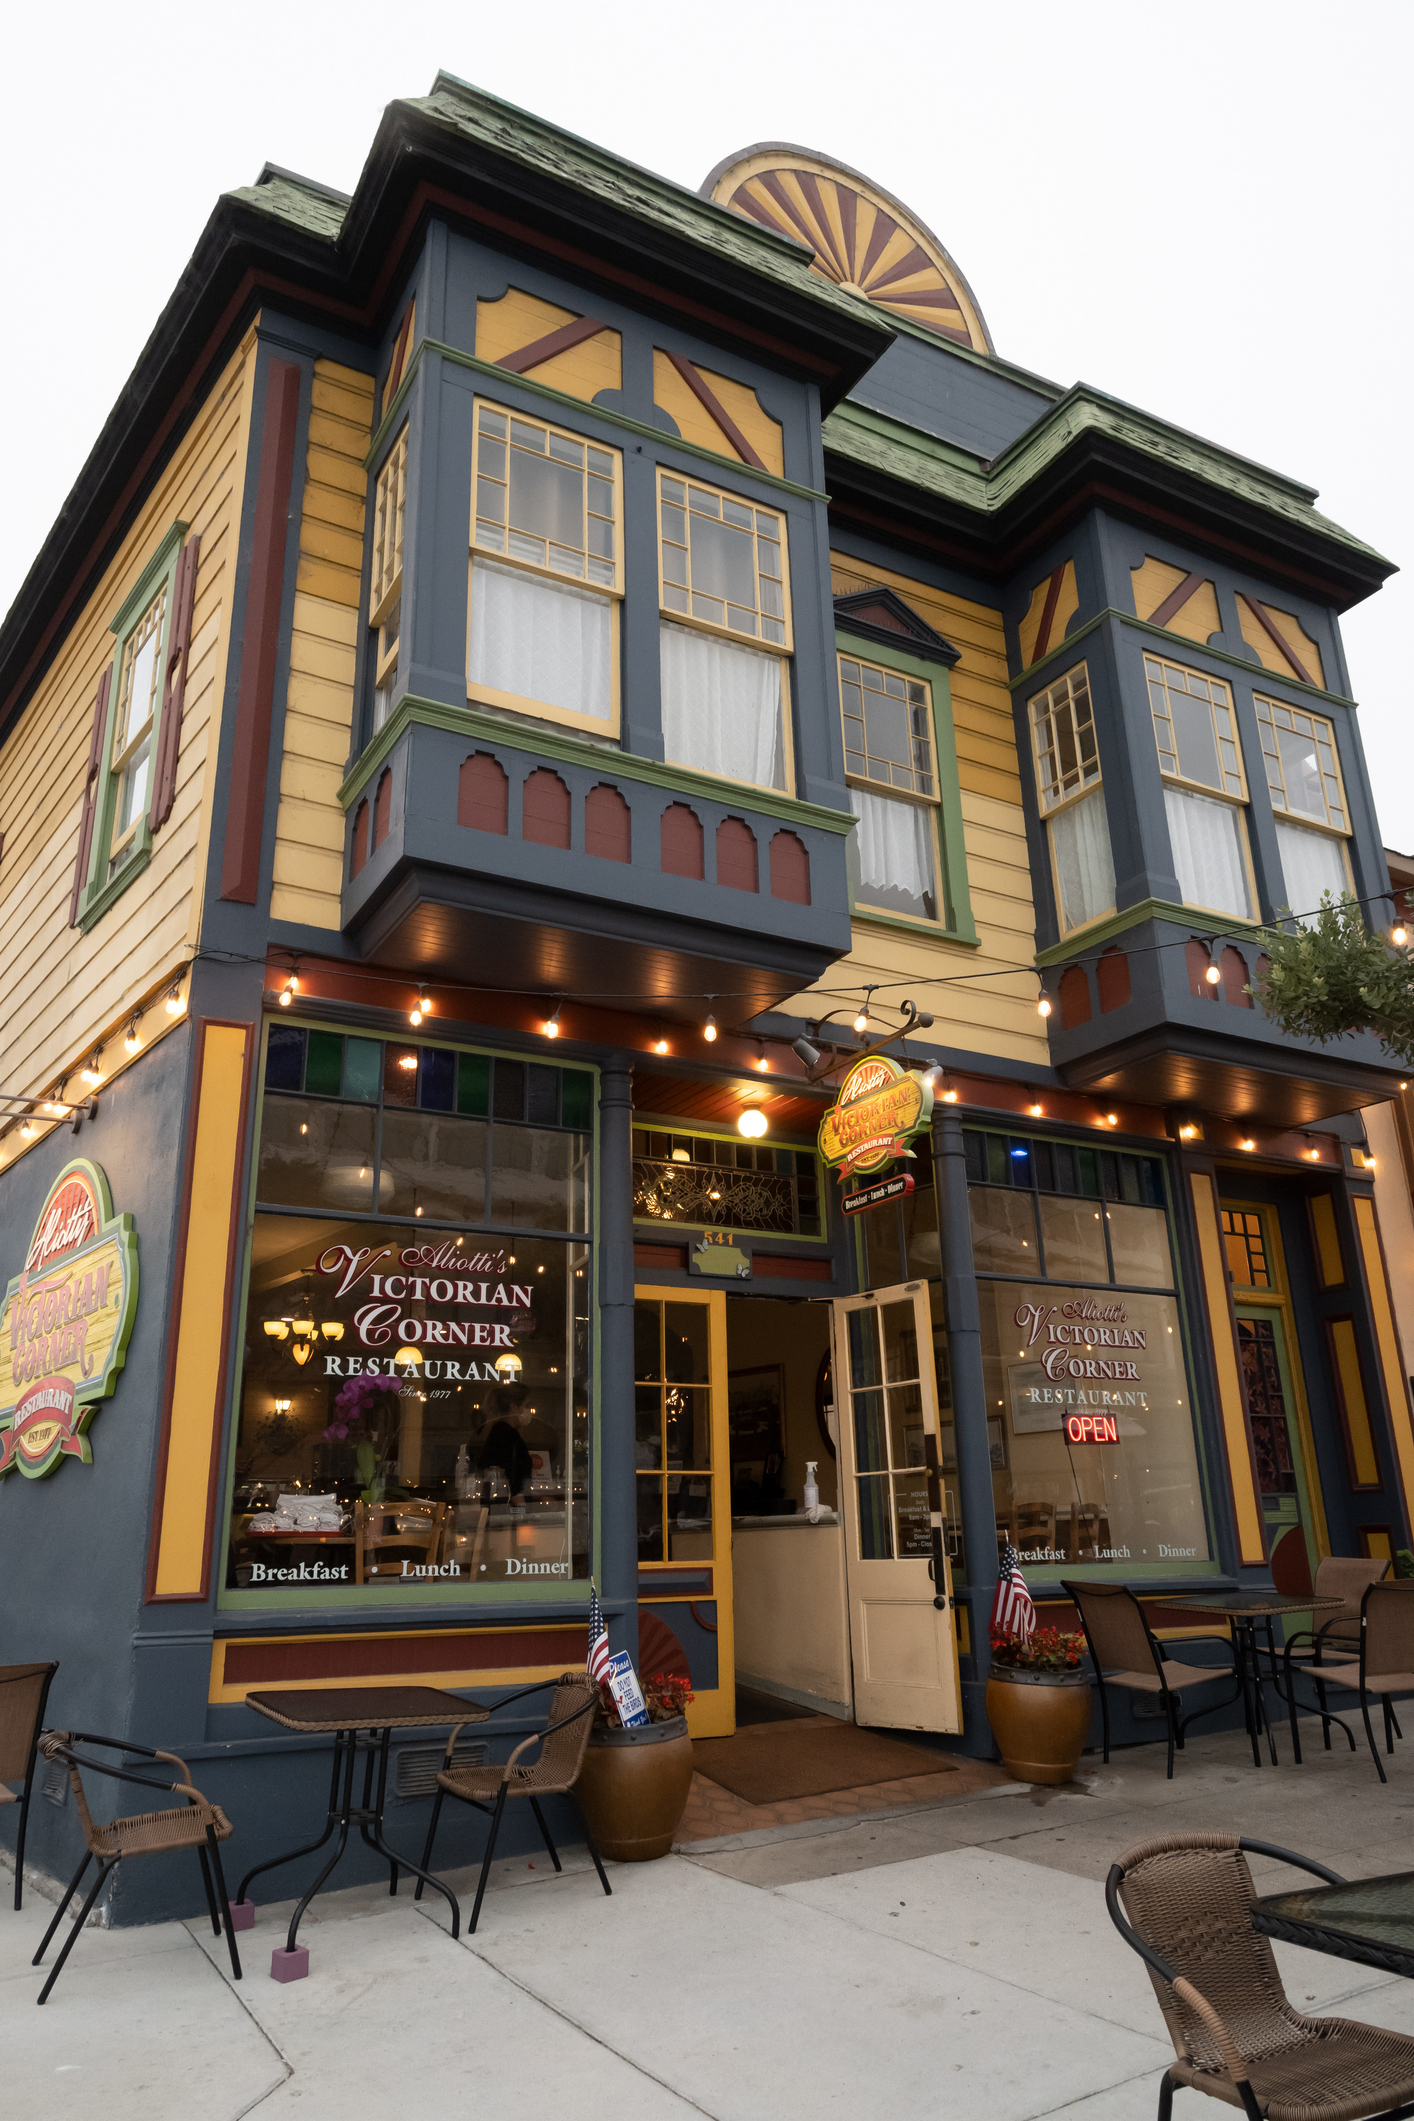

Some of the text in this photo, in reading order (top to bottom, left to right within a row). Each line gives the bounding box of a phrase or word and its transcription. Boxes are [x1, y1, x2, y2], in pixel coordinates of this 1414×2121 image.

[831, 1088, 908, 1135] VICTORIAN
[839, 1111, 905, 1146] CORNER
[846, 1137, 892, 1162] RESTAURANT
[871, 1187, 885, 1200] Lunch
[887, 1182, 903, 1194] Dinner
[704, 1231, 733, 1245] 541
[401, 1241, 507, 1274] Aliotti's
[317, 1245, 533, 1307] VICTORIAN
[10, 1262, 111, 1351] VICTORIAN
[1062, 1296, 1128, 1323] Aliotti's
[353, 1303, 515, 1348] CORNER
[1014, 1303, 1147, 1349] VICTORIAN
[12, 1319, 93, 1387] CORNER
[1041, 1347, 1141, 1382] CORNER
[323, 1355, 521, 1382] RESTAURANT
[429, 1390, 451, 1398] 1977
[1029, 1387, 1147, 1406] RESTAURANT
[14, 1389, 72, 1431] RESTAURANT
[1068, 1416, 1117, 1442] OPEN
[1094, 1545, 1130, 1559] Lunch
[1158, 1544, 1196, 1558] Dinner
[250, 1558, 568, 1581] Breakfast Lunch Dinner
[609, 1660, 630, 1674] Please
[617, 1676, 632, 1691] DO NOT
[624, 1688, 634, 1702] FEED
[622, 1696, 642, 1714] THE BIRDS
